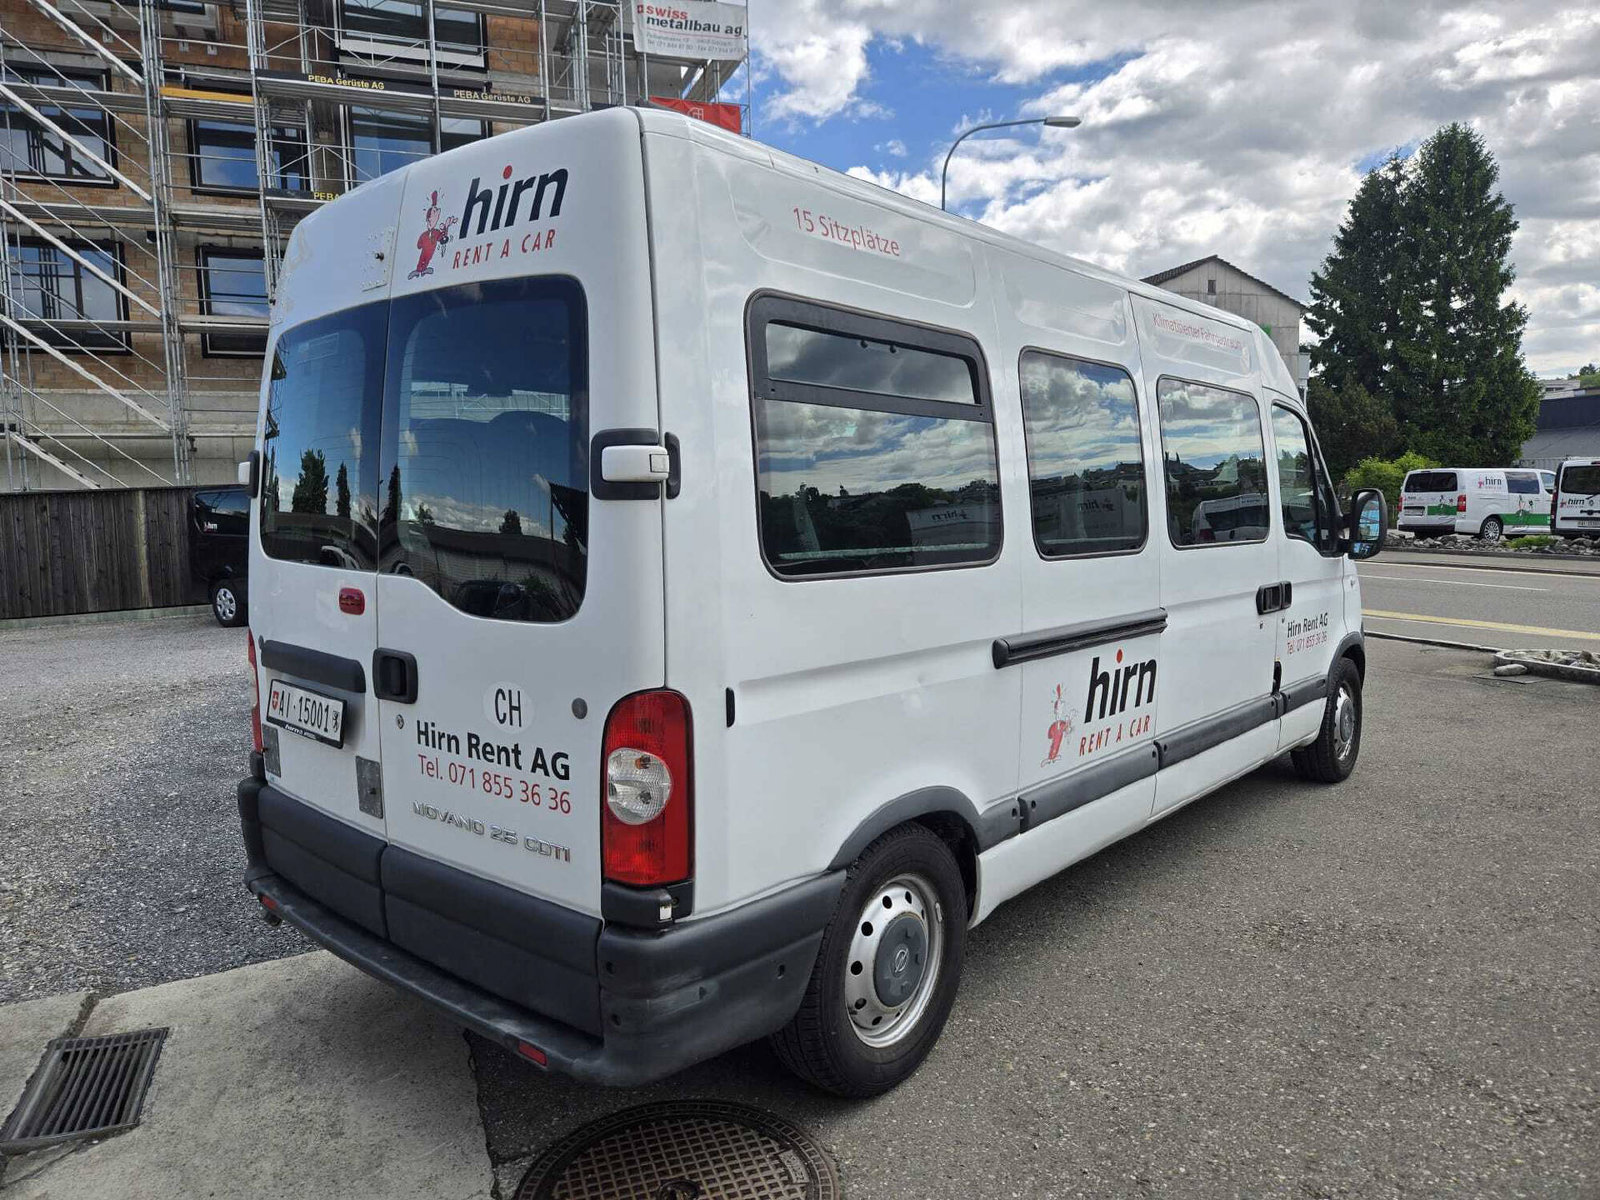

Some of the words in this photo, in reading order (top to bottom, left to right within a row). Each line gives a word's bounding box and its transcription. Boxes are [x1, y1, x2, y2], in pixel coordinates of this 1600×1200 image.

[646, 5, 688, 20] swiss
[646, 16, 721, 34] metallbau
[724, 25, 742, 36] ag
[308, 75, 334, 84] PEBA
[336, 78, 370, 88] Gerüste
[371, 81, 385, 90] AG
[453, 89, 480, 100] PEBA
[517, 96, 531, 104] AG
[459, 165, 569, 239] hirn
[453, 242, 493, 269] RENT
[500, 239, 510, 259] A
[521, 229, 556, 253] CAR
[793, 207, 814, 232] 15
[818, 214, 900, 257] Sitzplätze
[1287, 619, 1302, 638] Hirn
[1302, 616, 1318, 633] Rent
[1318, 612, 1328, 628] AG
[1084, 648, 1157, 724] hirn
[279, 690, 291, 718] AI
[298, 695, 330, 733] 15001
[494, 688, 522, 728] CH
[416, 720, 460, 755] Hirn
[467, 732, 523, 771] Rent
[530, 747, 570, 781] AG
[1079, 727, 1111, 757] RENT
[1116, 723, 1122, 743] A
[1129, 715, 1150, 738] CAR
[418, 754, 443, 780] Tel.
[448, 762, 475, 789] 071
[482, 771, 514, 799] 855
[519, 780, 542, 806] 36
[548, 787, 572, 814] 36
[412, 800, 485, 836] MOVANO
[524, 835, 571, 863] CDTI
